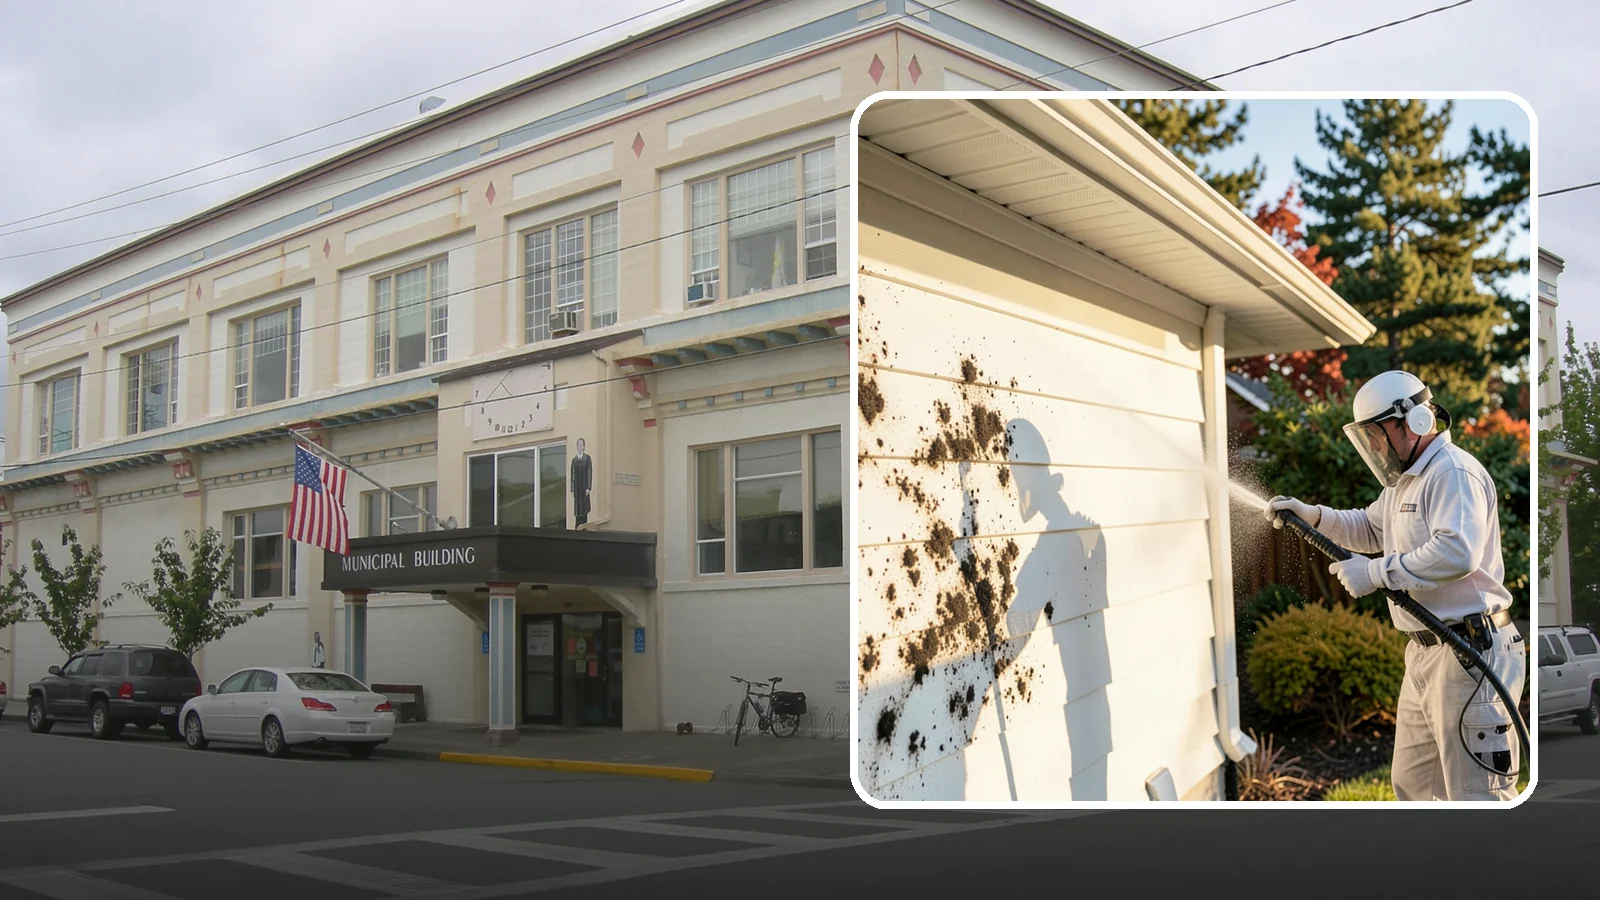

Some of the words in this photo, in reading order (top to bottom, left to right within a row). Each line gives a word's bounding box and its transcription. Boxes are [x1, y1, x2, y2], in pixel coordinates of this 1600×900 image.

[536, 402, 540, 410] 4
[488, 418, 492, 426] 9
[521, 420, 526, 428] 2
[494, 424, 500, 432] 10
[342, 552, 405, 572] MUNICIPAL
[414, 546, 475, 567] BUILDING
